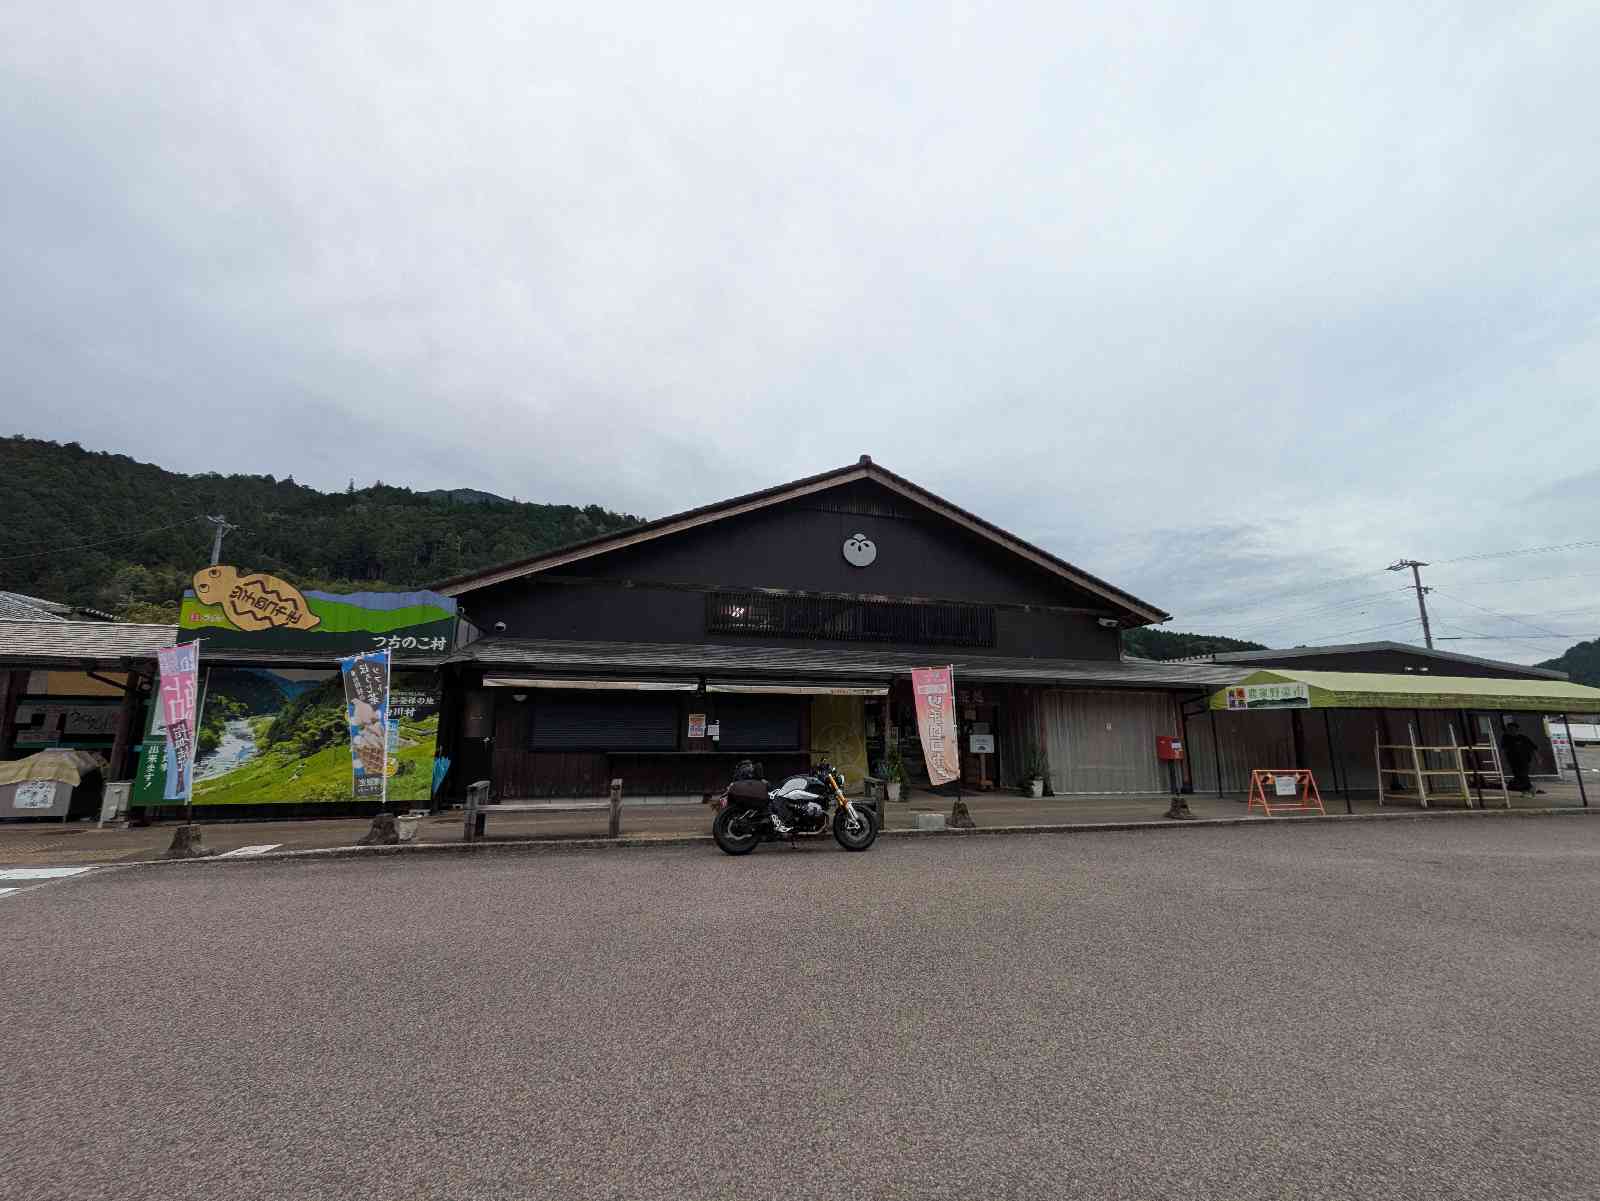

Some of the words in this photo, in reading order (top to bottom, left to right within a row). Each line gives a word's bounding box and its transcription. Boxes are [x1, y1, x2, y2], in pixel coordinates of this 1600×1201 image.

[371, 635, 447, 651] つちのこ村
